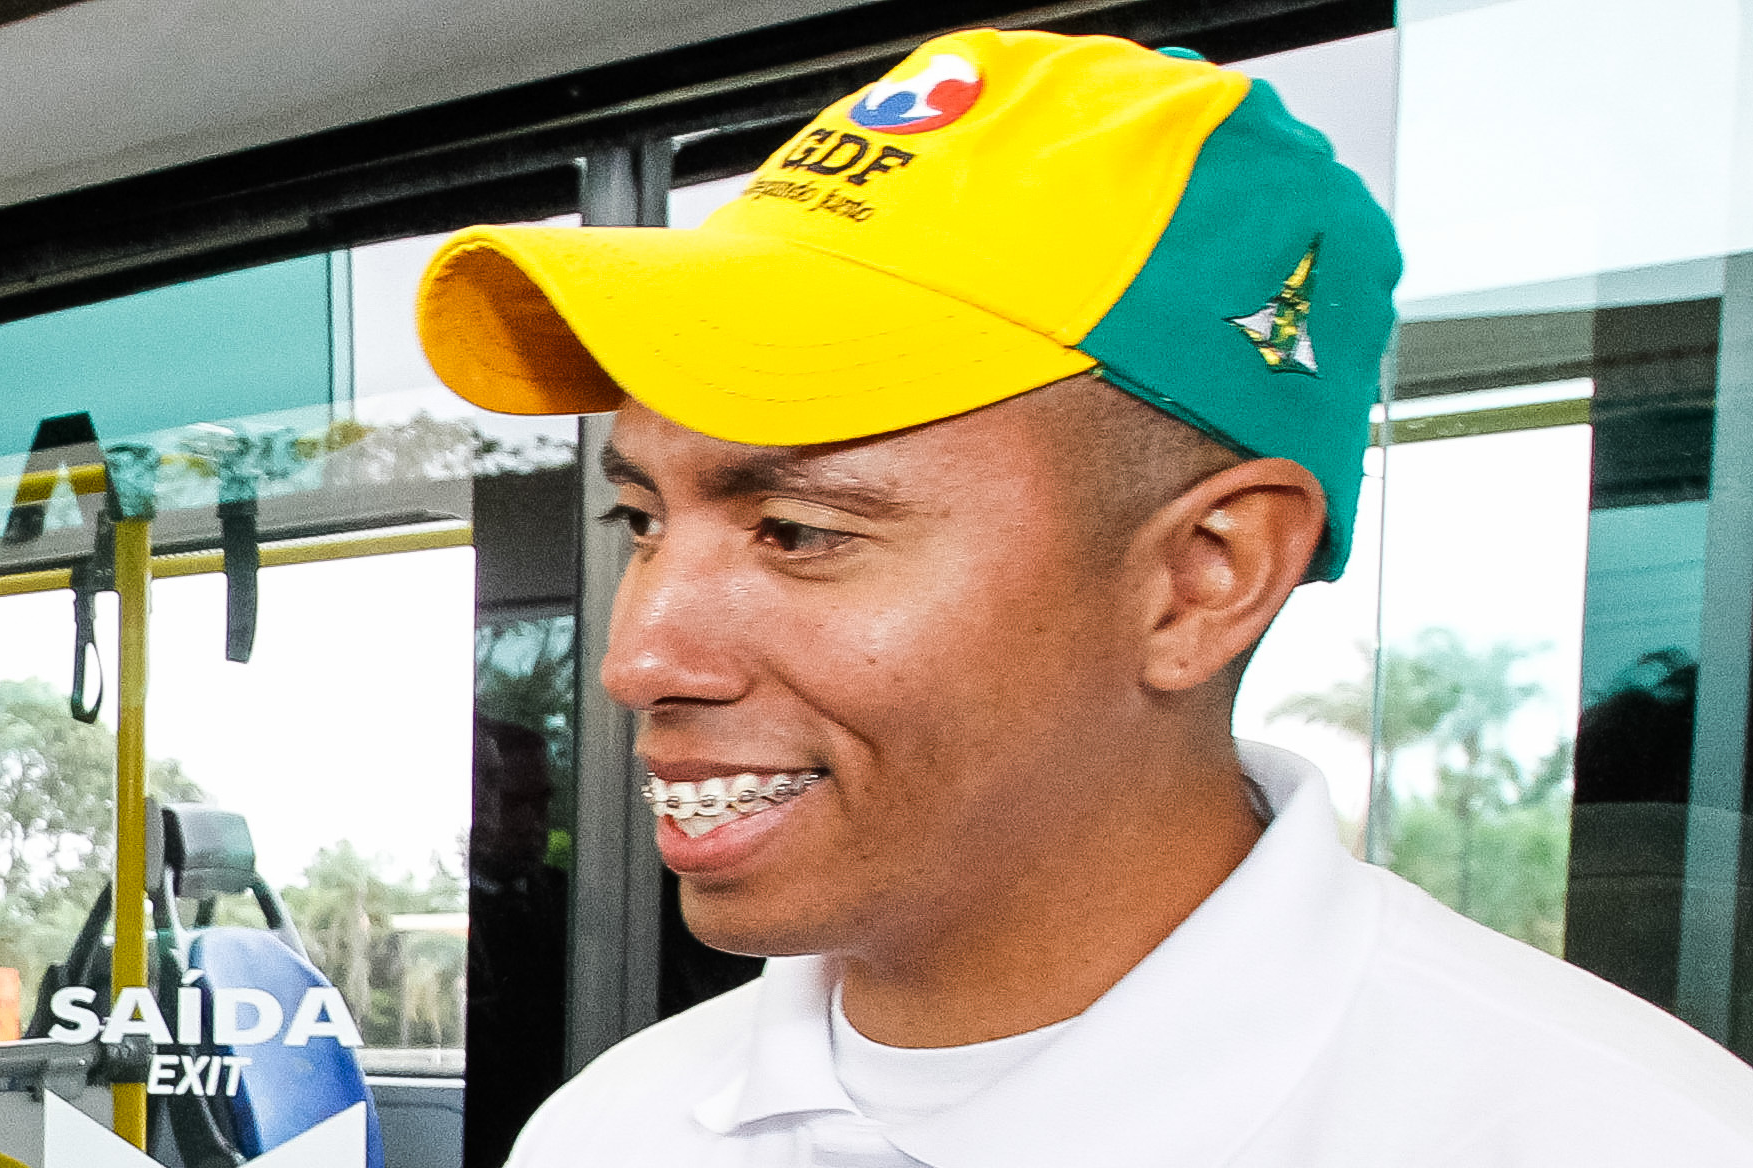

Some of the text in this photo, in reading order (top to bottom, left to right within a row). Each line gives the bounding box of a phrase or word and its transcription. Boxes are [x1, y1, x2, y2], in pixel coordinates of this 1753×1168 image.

[780, 128, 915, 186] GDF
[48, 968, 365, 1047] SAÍDA
[148, 1054, 252, 1097] EXIT
